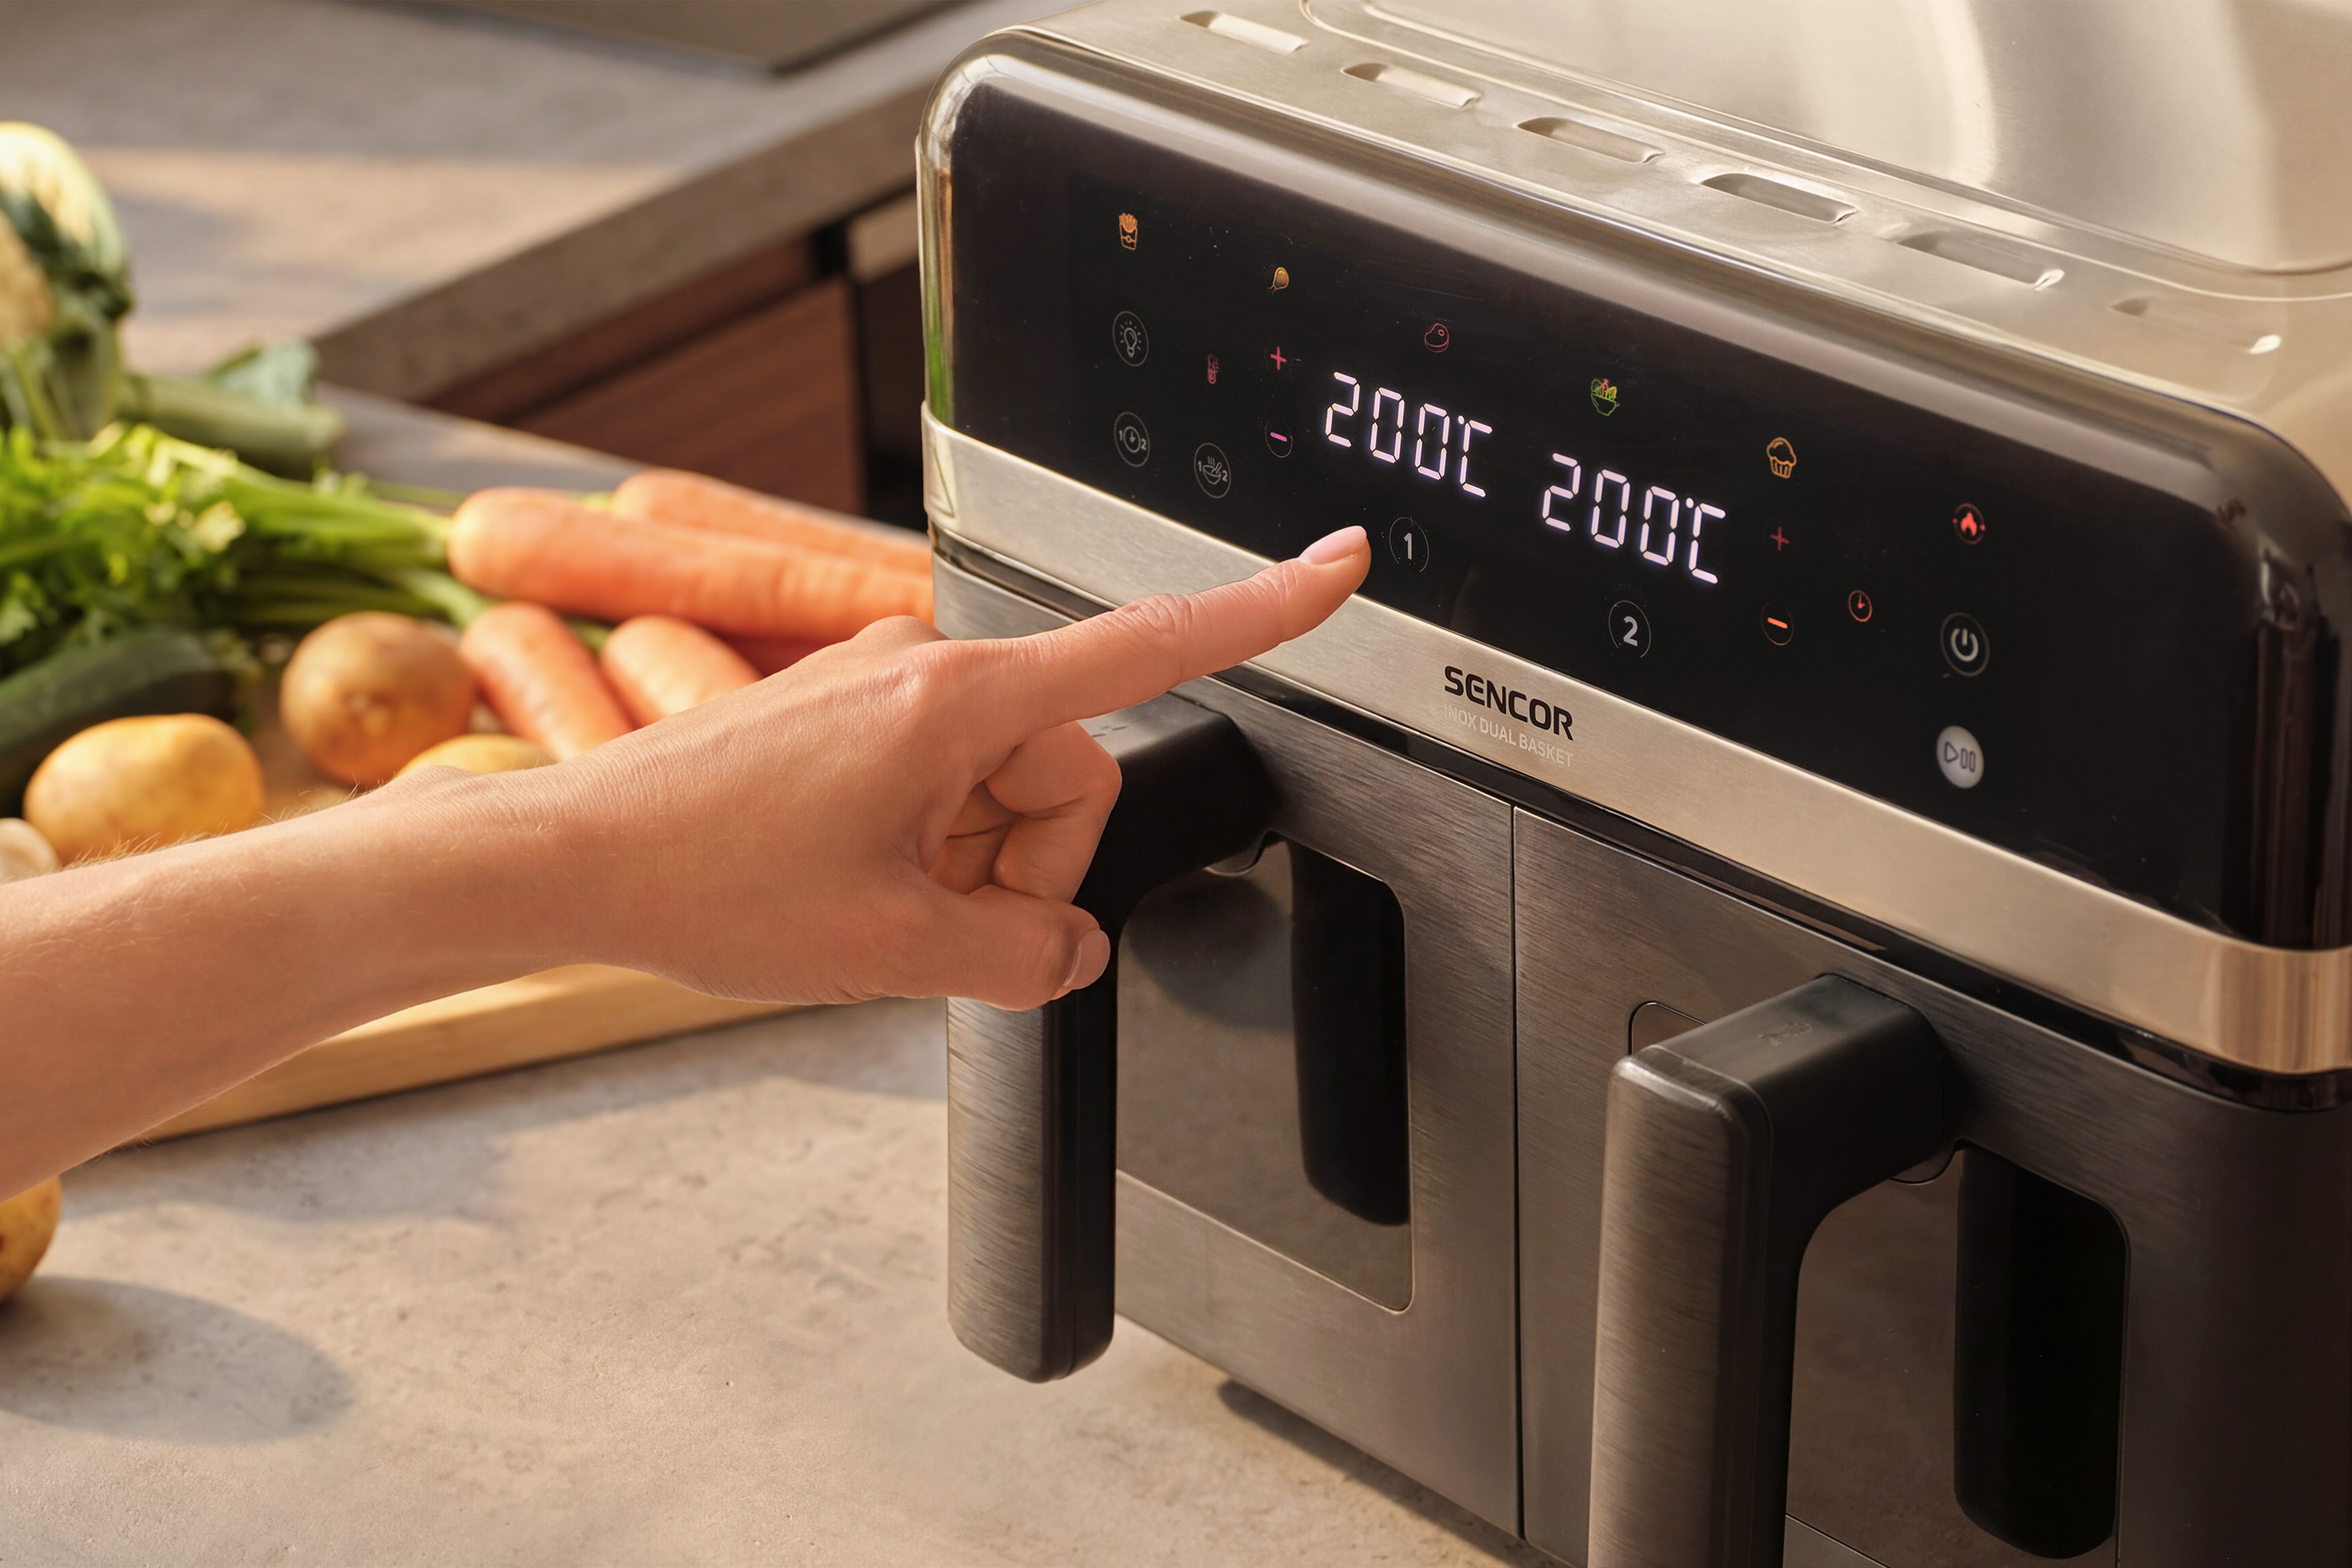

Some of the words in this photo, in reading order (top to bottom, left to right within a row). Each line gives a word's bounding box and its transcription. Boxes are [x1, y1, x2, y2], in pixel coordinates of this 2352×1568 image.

[1404, 533, 1411, 559] 1
[1623, 616, 1638, 646] 2
[1444, 666, 1573, 742] SENCOR
[1444, 703, 1477, 730] INOX
[1480, 717, 1517, 746] DUAL
[1519, 732, 1574, 767] BASKET
